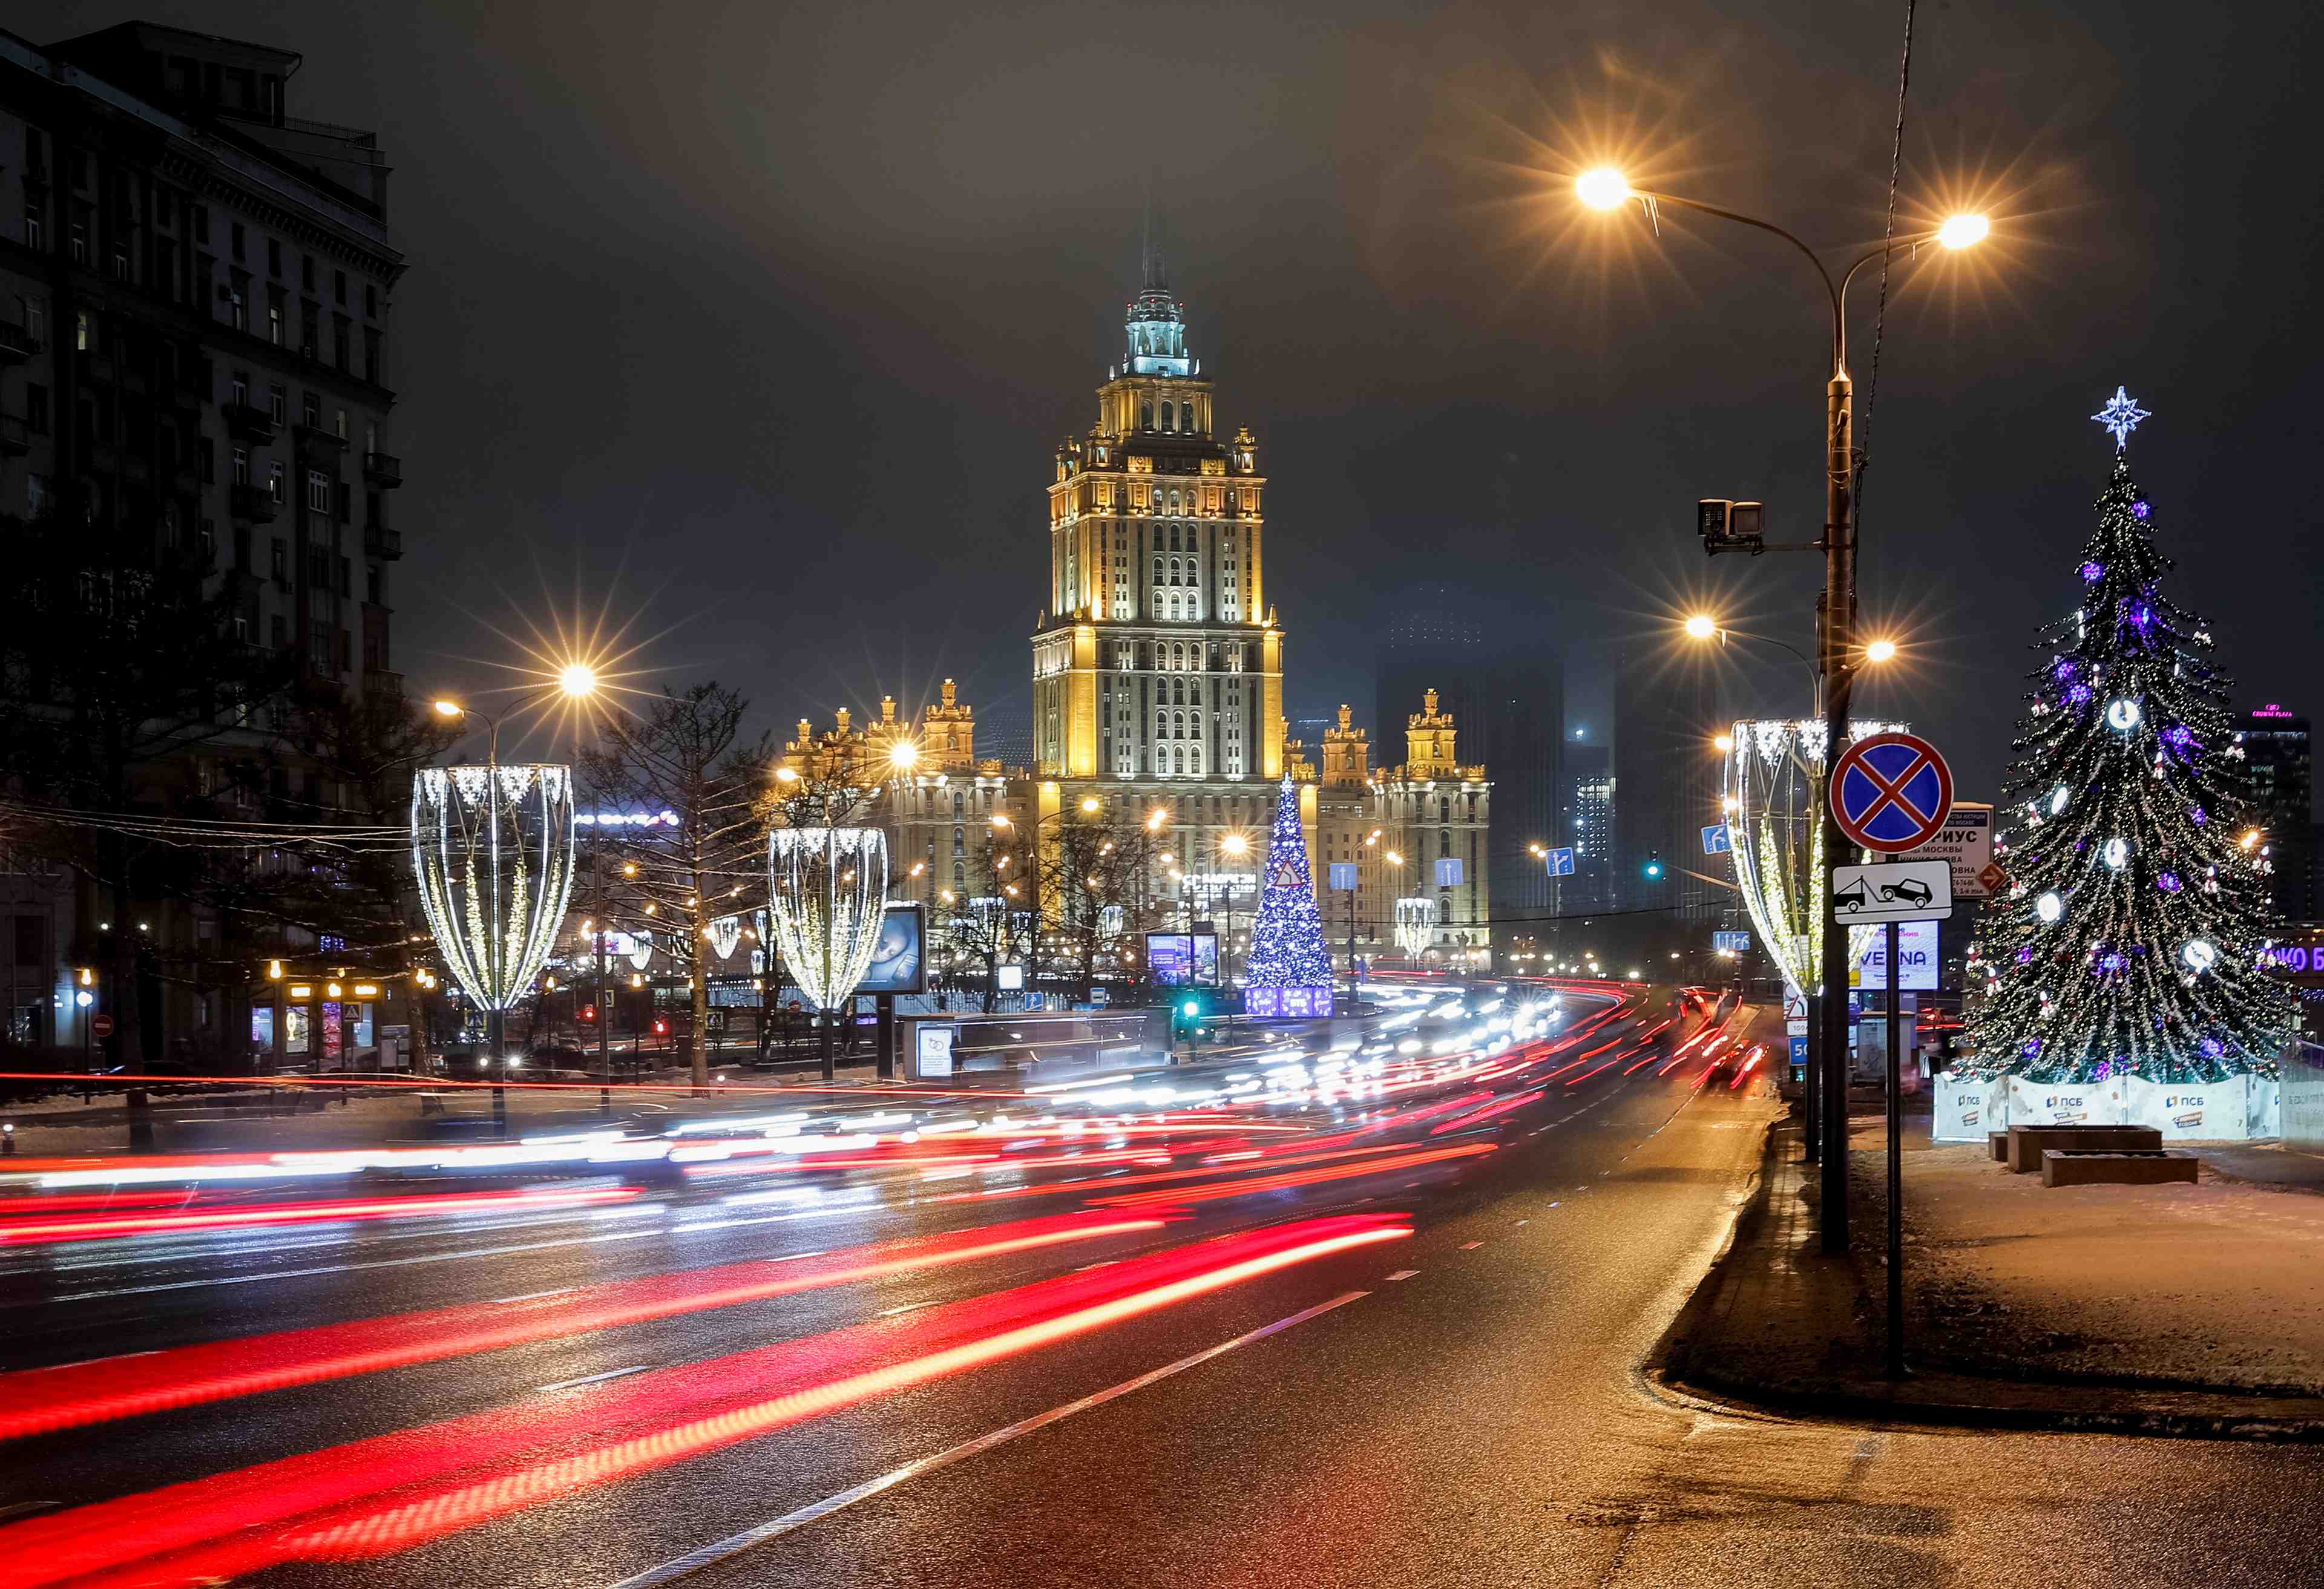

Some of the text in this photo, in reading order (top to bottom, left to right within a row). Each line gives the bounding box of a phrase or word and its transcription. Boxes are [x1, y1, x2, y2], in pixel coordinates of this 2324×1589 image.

[1932, 831, 1977, 843] РИУС
[1861, 951, 1926, 966] VENA
[1967, 1096, 1980, 1105] ПСБ
[2061, 1098, 2083, 1106] ПСБ
[2181, 1097, 2204, 1106] ПСБ
